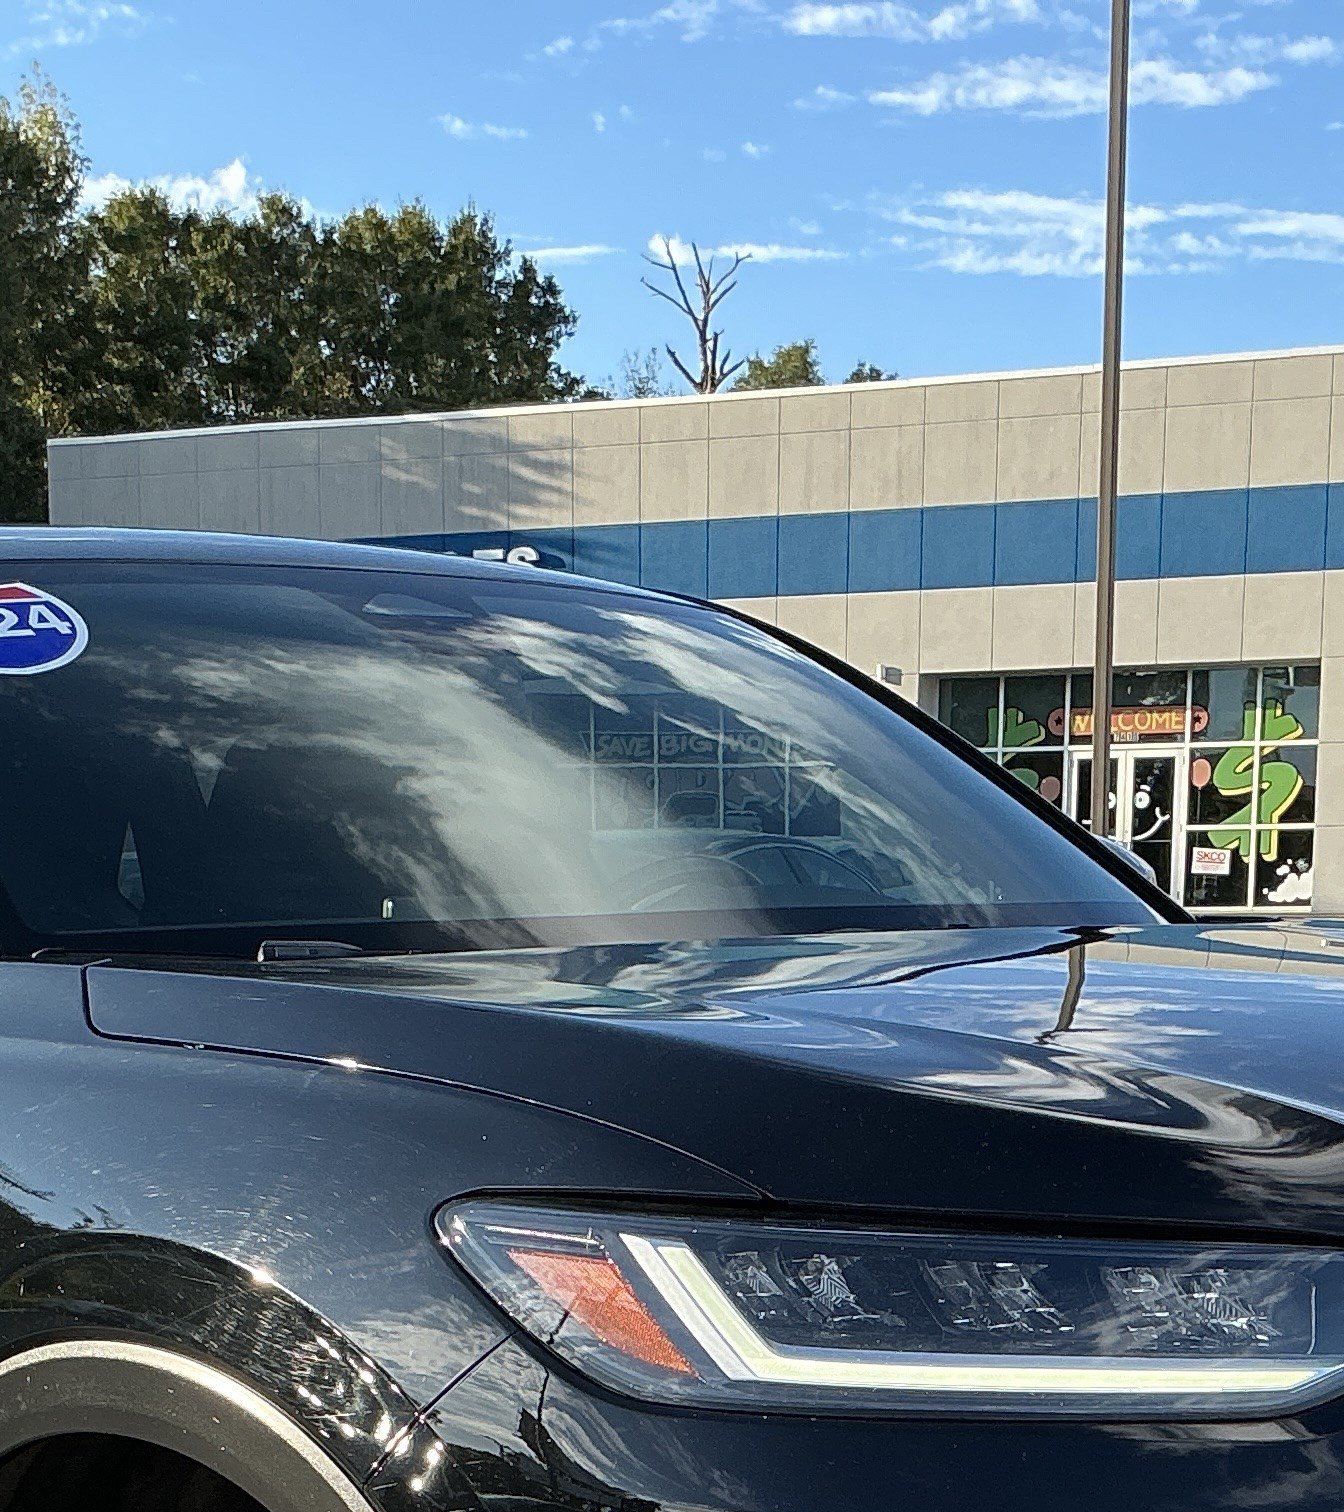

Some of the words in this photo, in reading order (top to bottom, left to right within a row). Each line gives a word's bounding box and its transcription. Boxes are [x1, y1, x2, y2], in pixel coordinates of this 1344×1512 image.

[1073, 710, 1186, 731] WCOME
[597, 736, 652, 758] SAVE
[660, 736, 714, 755] BIG
[1196, 850, 1226, 862] SKCO
